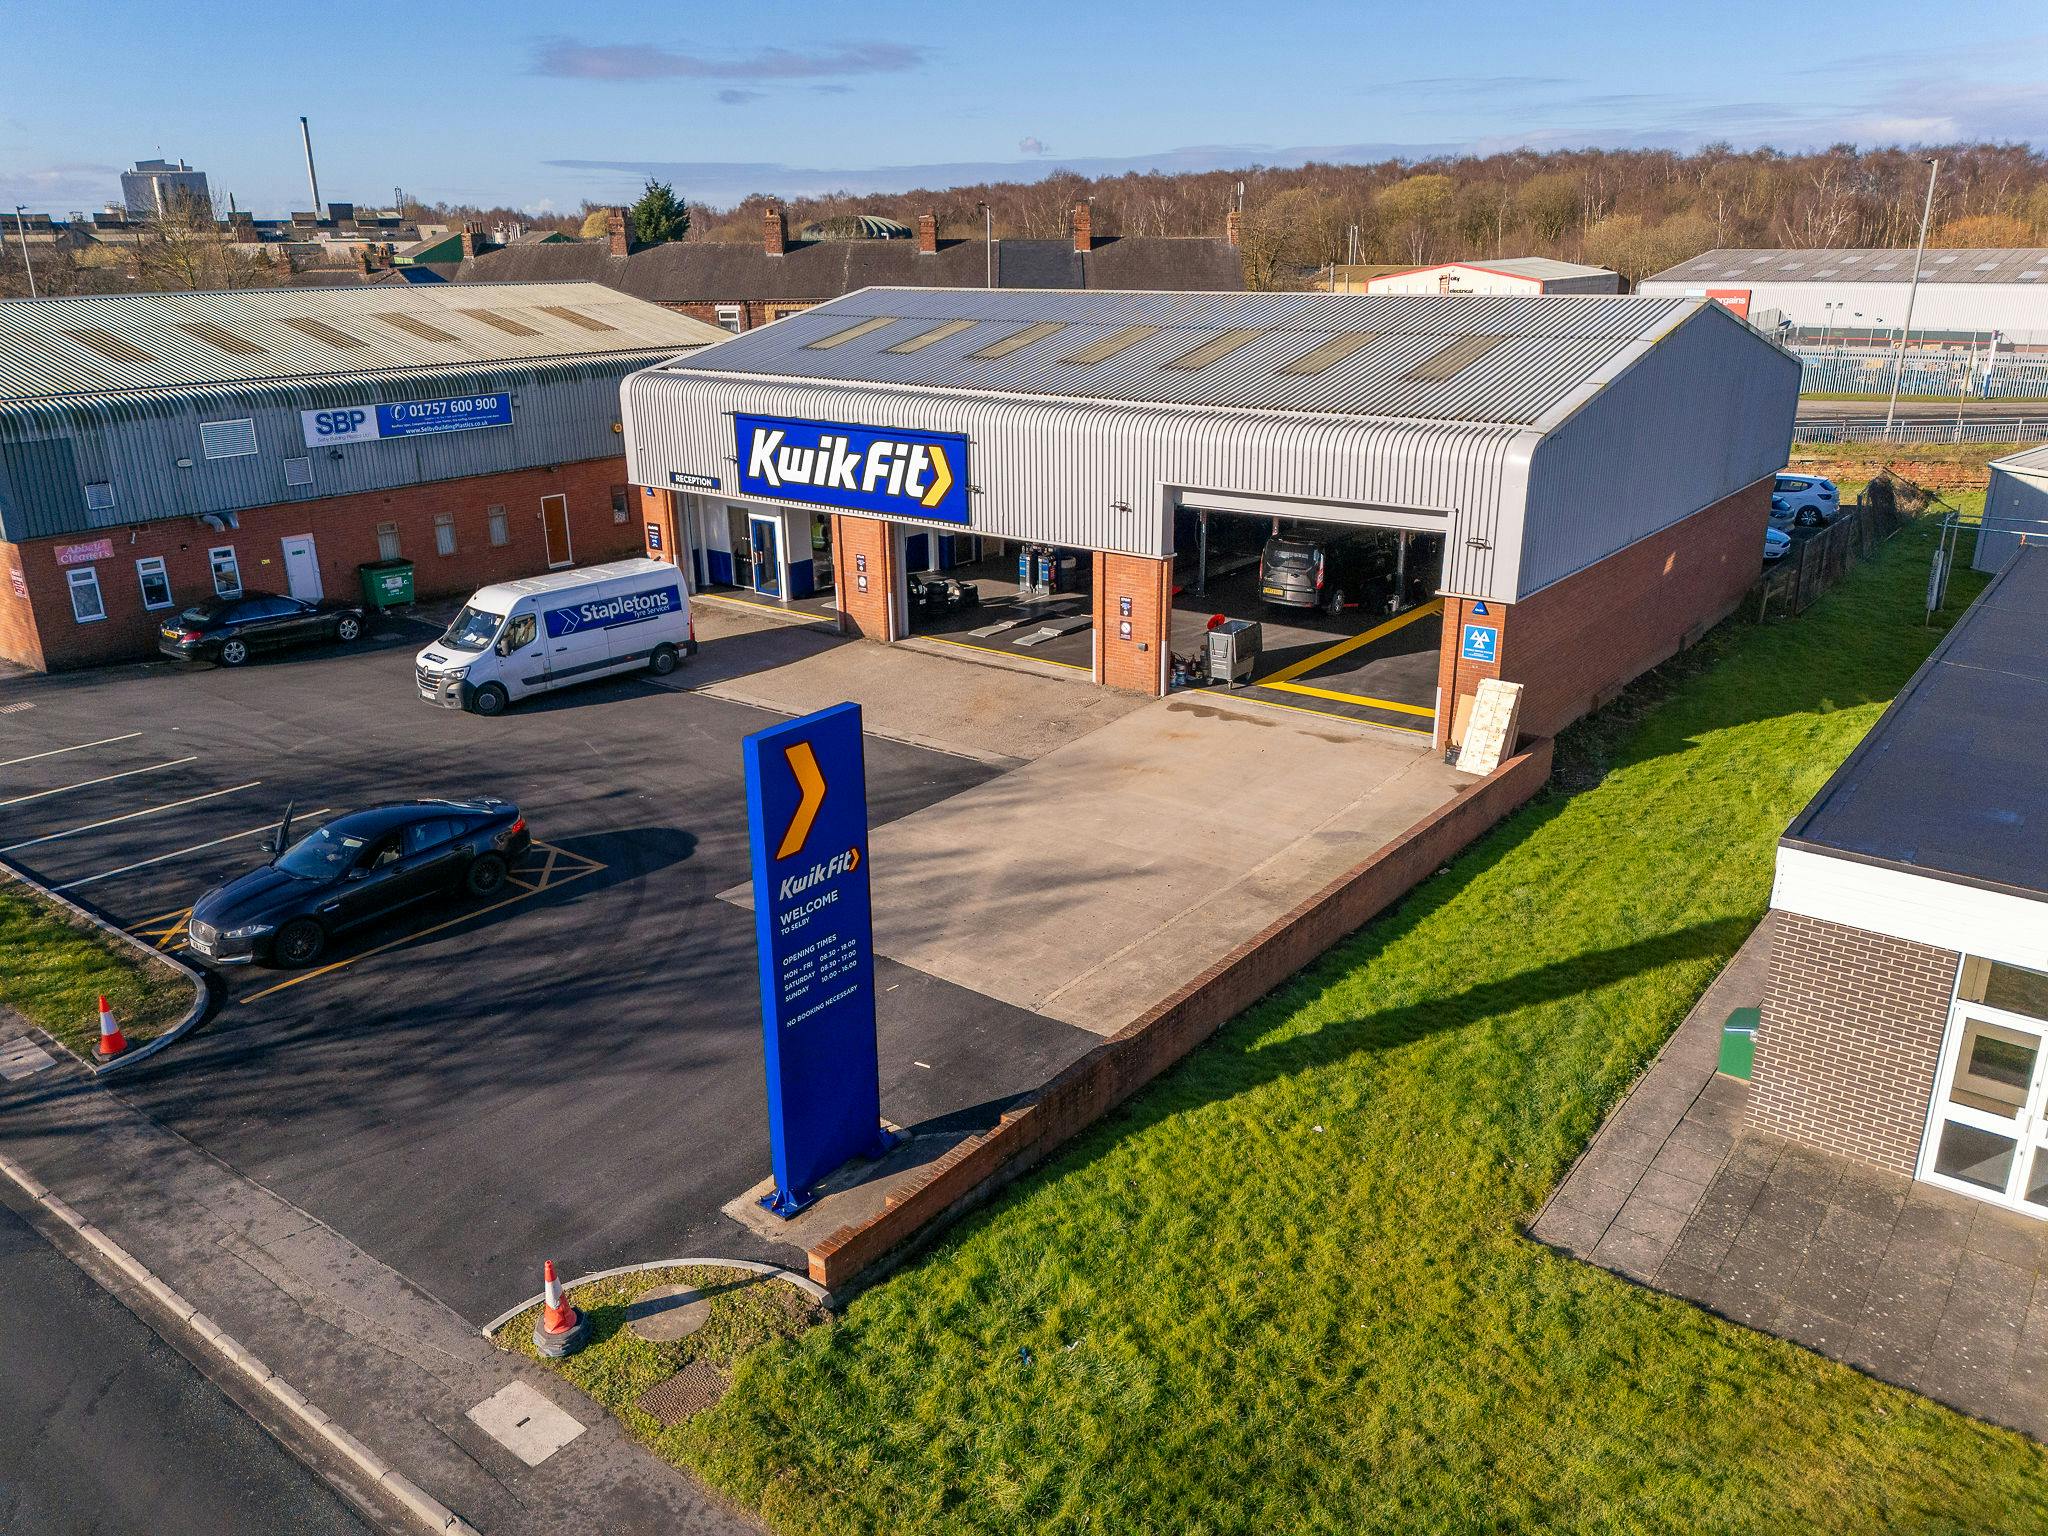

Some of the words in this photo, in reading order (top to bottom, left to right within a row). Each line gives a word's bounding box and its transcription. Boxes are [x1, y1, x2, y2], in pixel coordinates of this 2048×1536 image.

[315, 409, 366, 436] SBP
[409, 402, 447, 418] 01757
[450, 399, 473, 414] 600
[475, 397, 498, 412] 900
[748, 428, 862, 490] Kwik
[861, 440, 929, 498] Fit
[675, 474, 712, 487] RECEPTION
[580, 592, 669, 622] Stapletons
[633, 609, 646, 619] Tyre
[646, 604, 670, 616] Services
[780, 863, 827, 901] Kwik
[826, 850, 852, 879] Fit
[780, 889, 839, 926] WELCOME
[780, 927, 790, 936] TO
[790, 916, 810, 931] SELBY
[782, 944, 816, 966] OPENING
[816, 933, 837, 949] TIMES
[783, 968, 799, 981] MON
[803, 961, 814, 971] FRI
[819, 949, 837, 962] 08.30
[784, 970, 816, 992] SATURDAY
[785, 984, 810, 1003] SUNDAY
[821, 970, 838, 983] 10.00
[786, 1018, 797, 1028] NO
[797, 1002, 825, 1022] BOOKING
[825, 984, 858, 1007] NECESSARY
